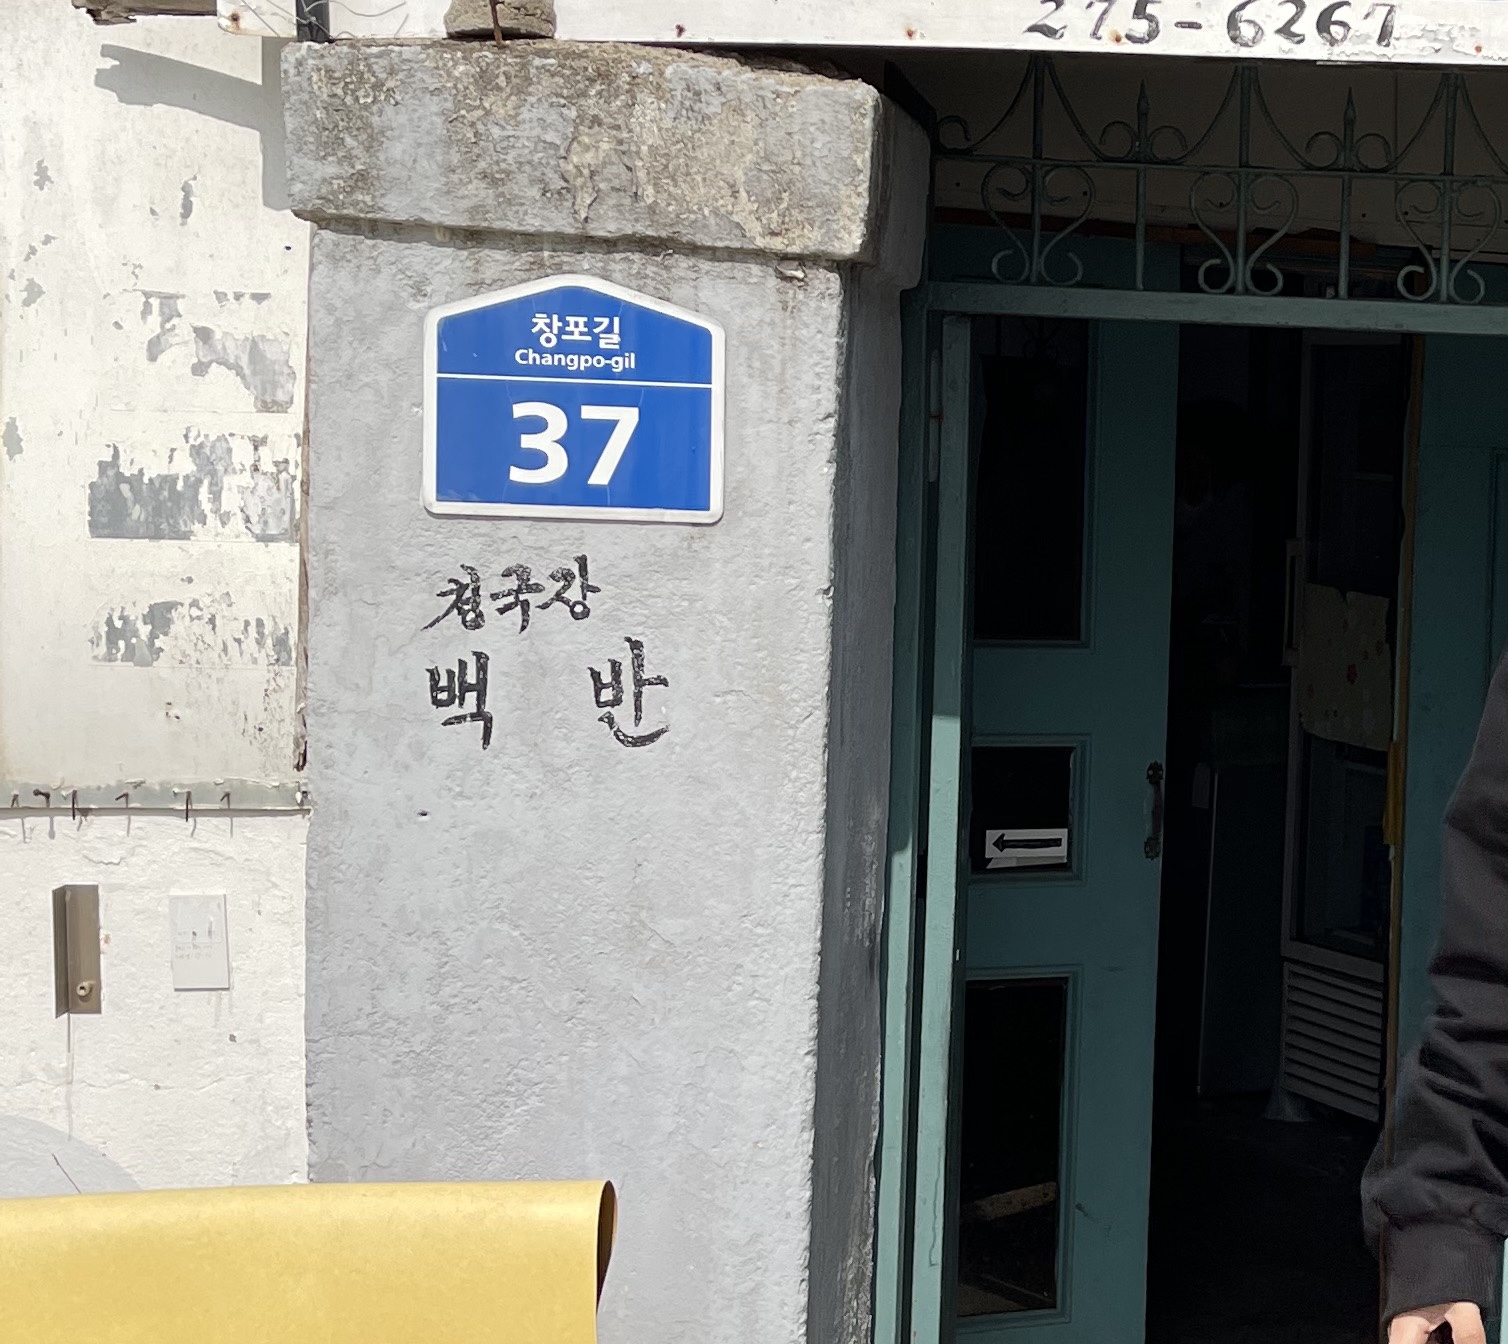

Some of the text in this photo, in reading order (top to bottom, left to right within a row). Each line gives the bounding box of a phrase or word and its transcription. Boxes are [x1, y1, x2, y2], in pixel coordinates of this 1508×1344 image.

[514, 348, 636, 373] Changpo-gil
[531, 313, 622, 350] 창포길
[508, 401, 641, 486] 37
[420, 554, 602, 635] 청국장
